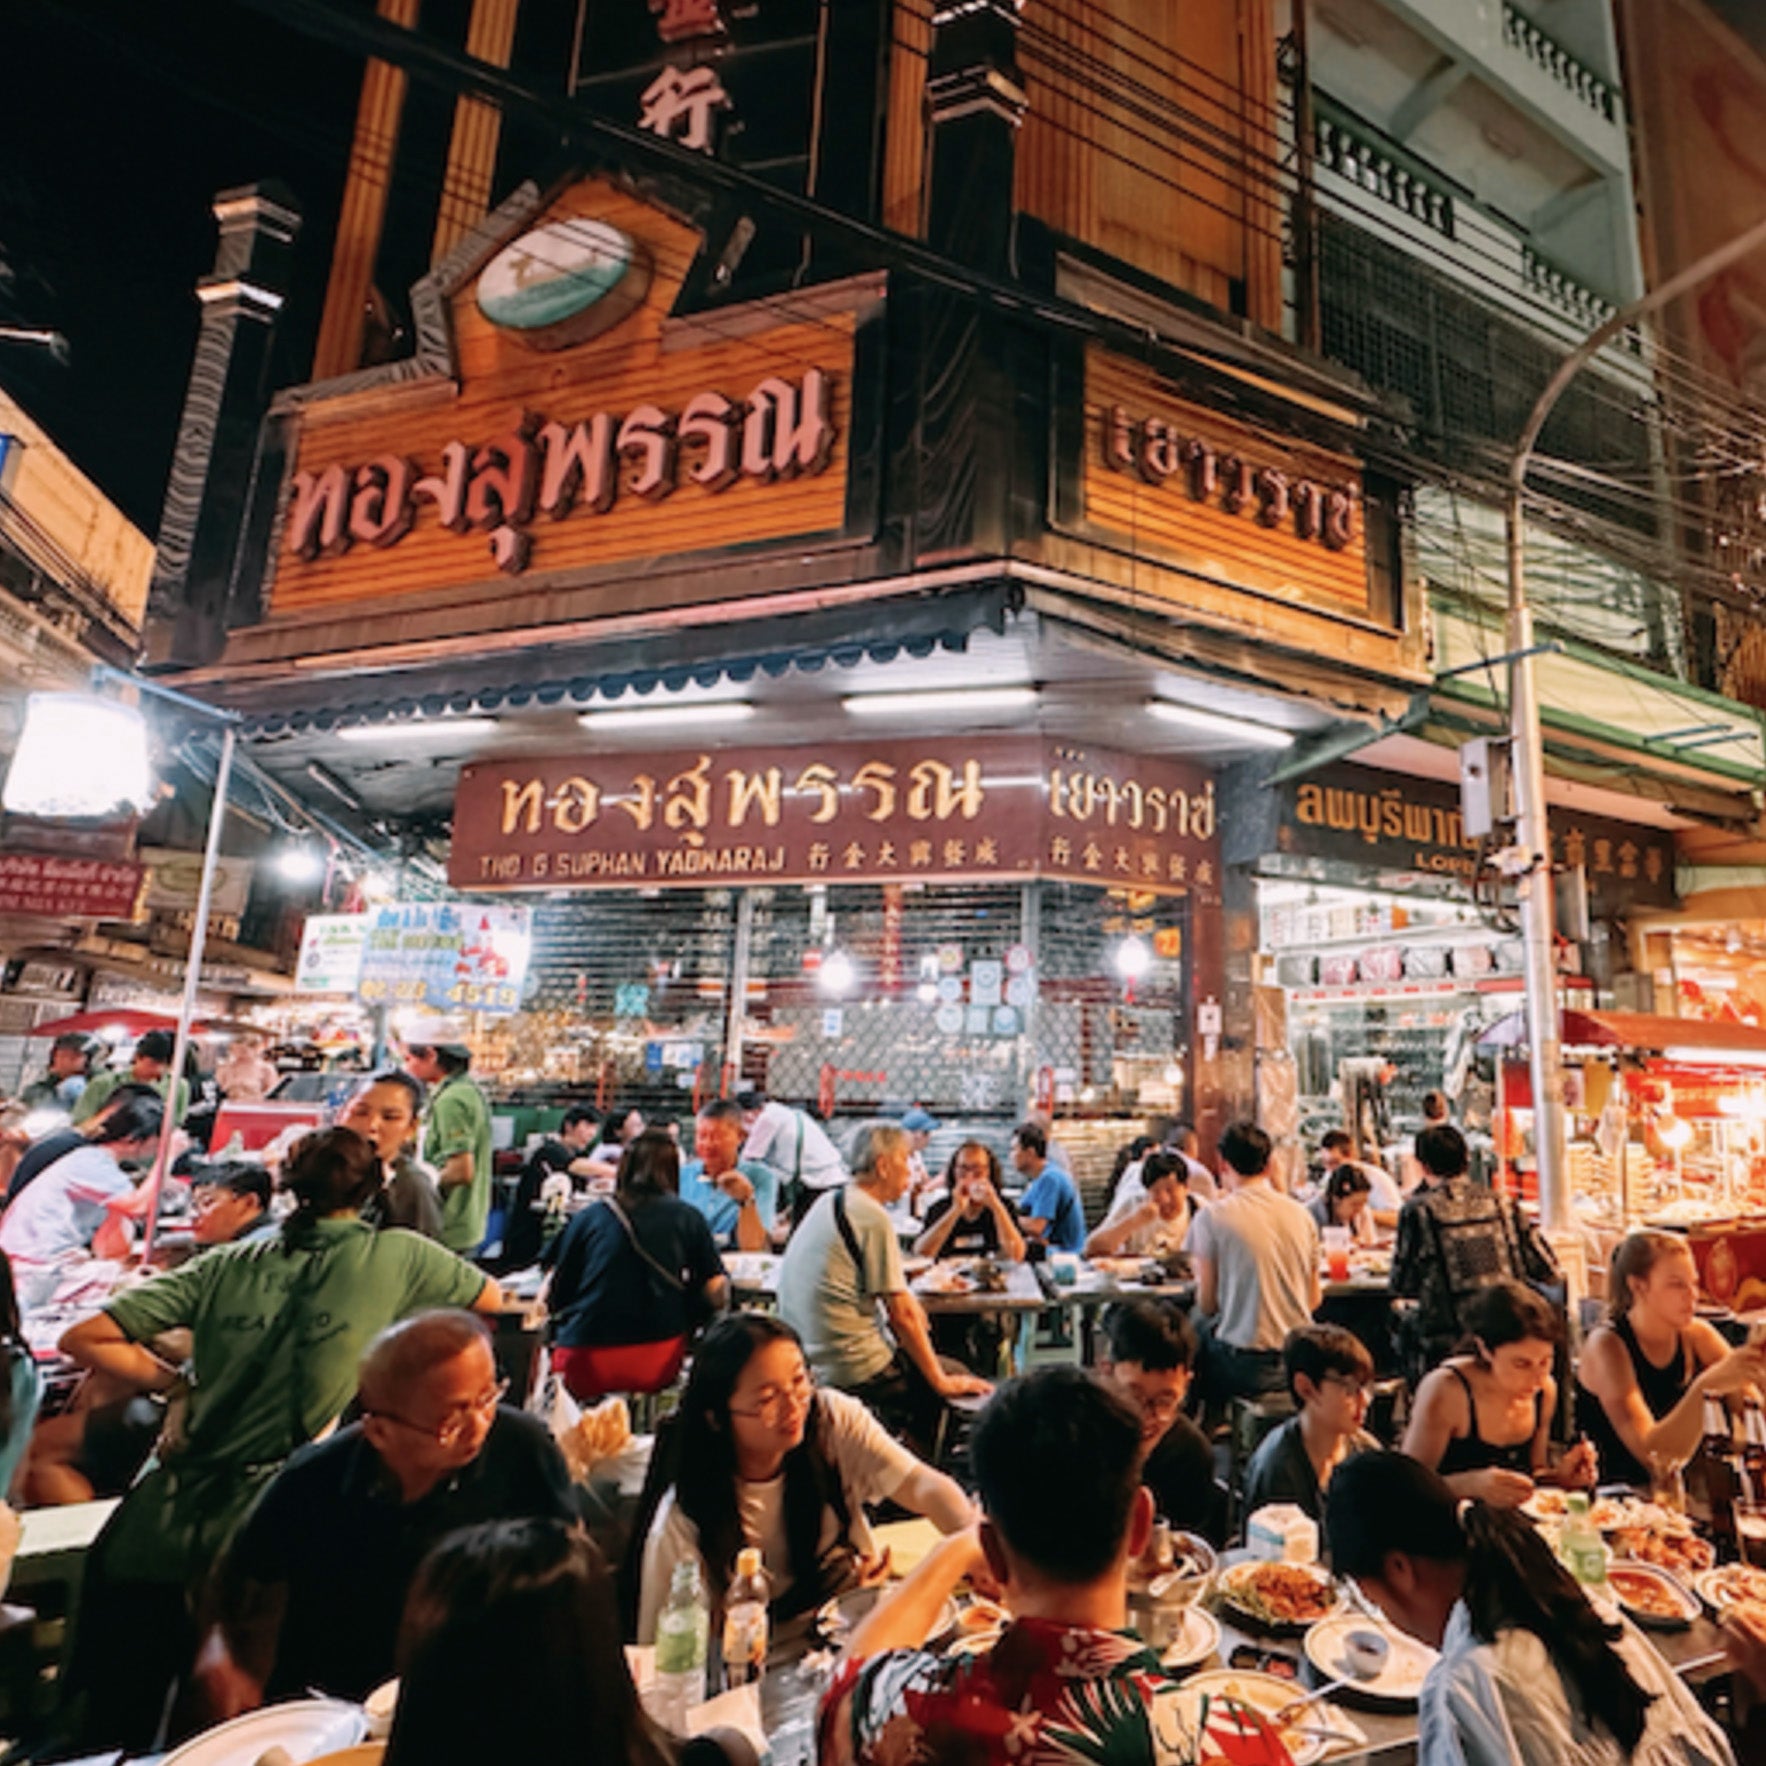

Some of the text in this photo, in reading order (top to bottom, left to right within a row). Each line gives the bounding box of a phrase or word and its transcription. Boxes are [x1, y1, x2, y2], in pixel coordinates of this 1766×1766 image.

[289, 367, 834, 571] ทองสุพรรณ
[500, 755, 984, 848] ทองสุพรรณ
[556, 851, 646, 876] SUPHAN
